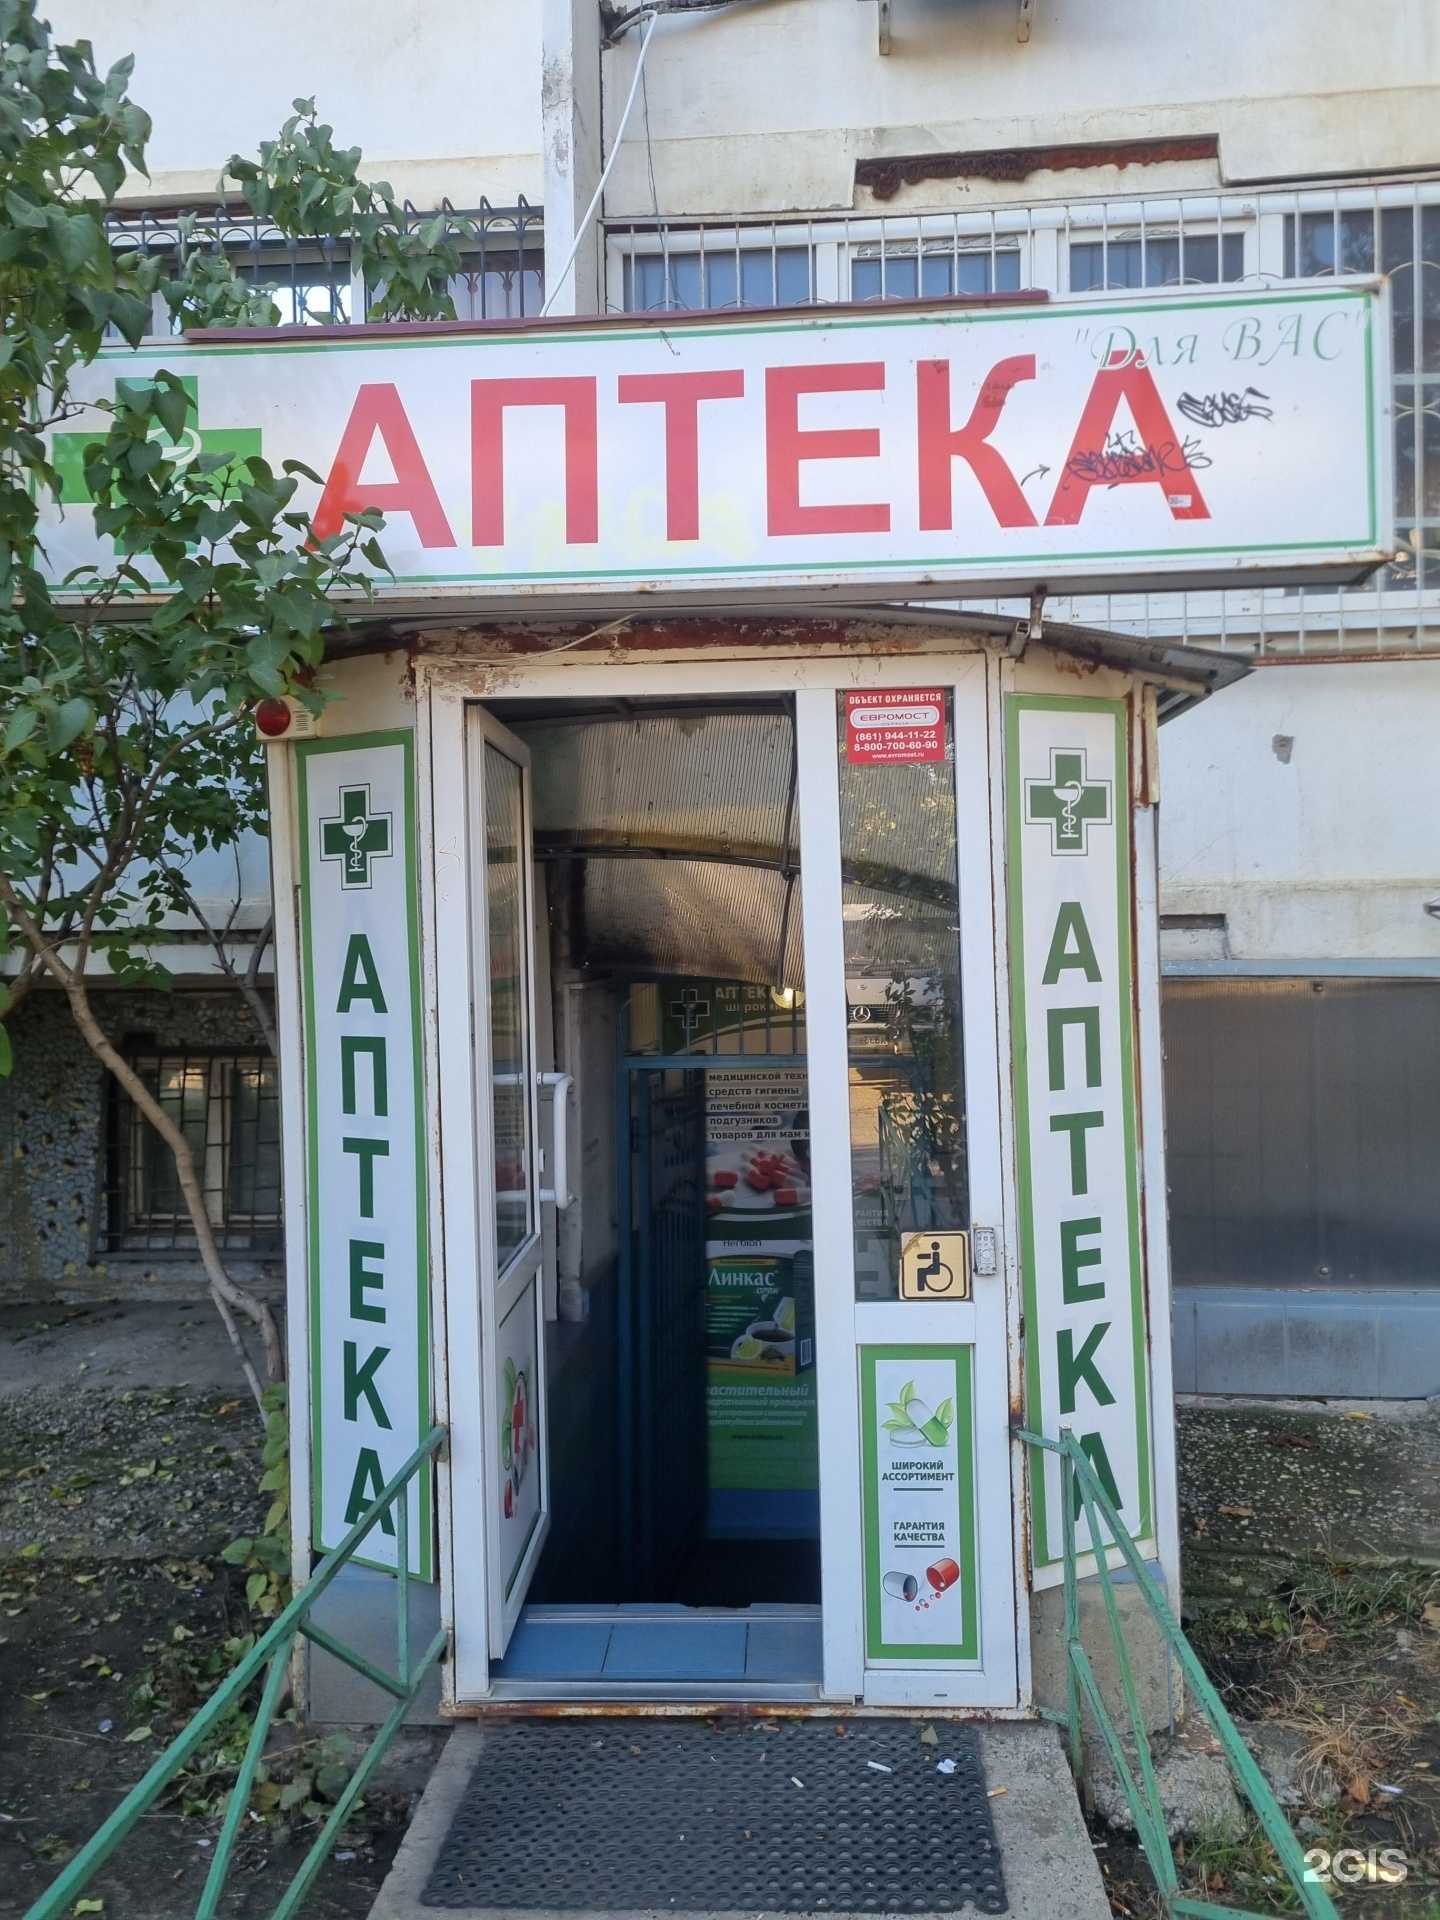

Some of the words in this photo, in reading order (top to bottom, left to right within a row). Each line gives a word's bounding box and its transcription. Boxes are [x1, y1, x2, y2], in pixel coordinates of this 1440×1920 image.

[303, 348, 1212, 552] АПТЕКА
[849, 695, 882, 705] ОБЪЕКТ
[885, 693, 942, 703] ОХРАНЯЕТСЯ
[860, 712, 929, 721] ЕВРОМОСТ
[855, 733, 882, 742] (861)
[885, 730, 936, 740] 944-11-22
[854, 741, 938, 751] 8-800-700-60-90
[709, 1072, 780, 1082] медицинской
[709, 1088, 752, 1098] средств
[755, 1087, 799, 1095] гигиены
[710, 1101, 761, 1111] лечебной
[710, 1117, 778, 1127] подгузников
[710, 1132, 753, 1141] товаров
[756, 1131, 777, 1140] для
[1041, 901, 1123, 1522] АПТЕКА
[336, 933, 396, 1537] АПТЕКА
[708, 1267, 776, 1287] Линкас
[706, 1383, 809, 1396] астительный
[891, 1459, 944, 1470] ШИРОКИЙ
[881, 1472, 955, 1481] АССОРТИМЕНТ
[893, 1521, 945, 1531] ГАРАНТИЯ
[893, 1532, 945, 1542] КАЧЕСТВА
